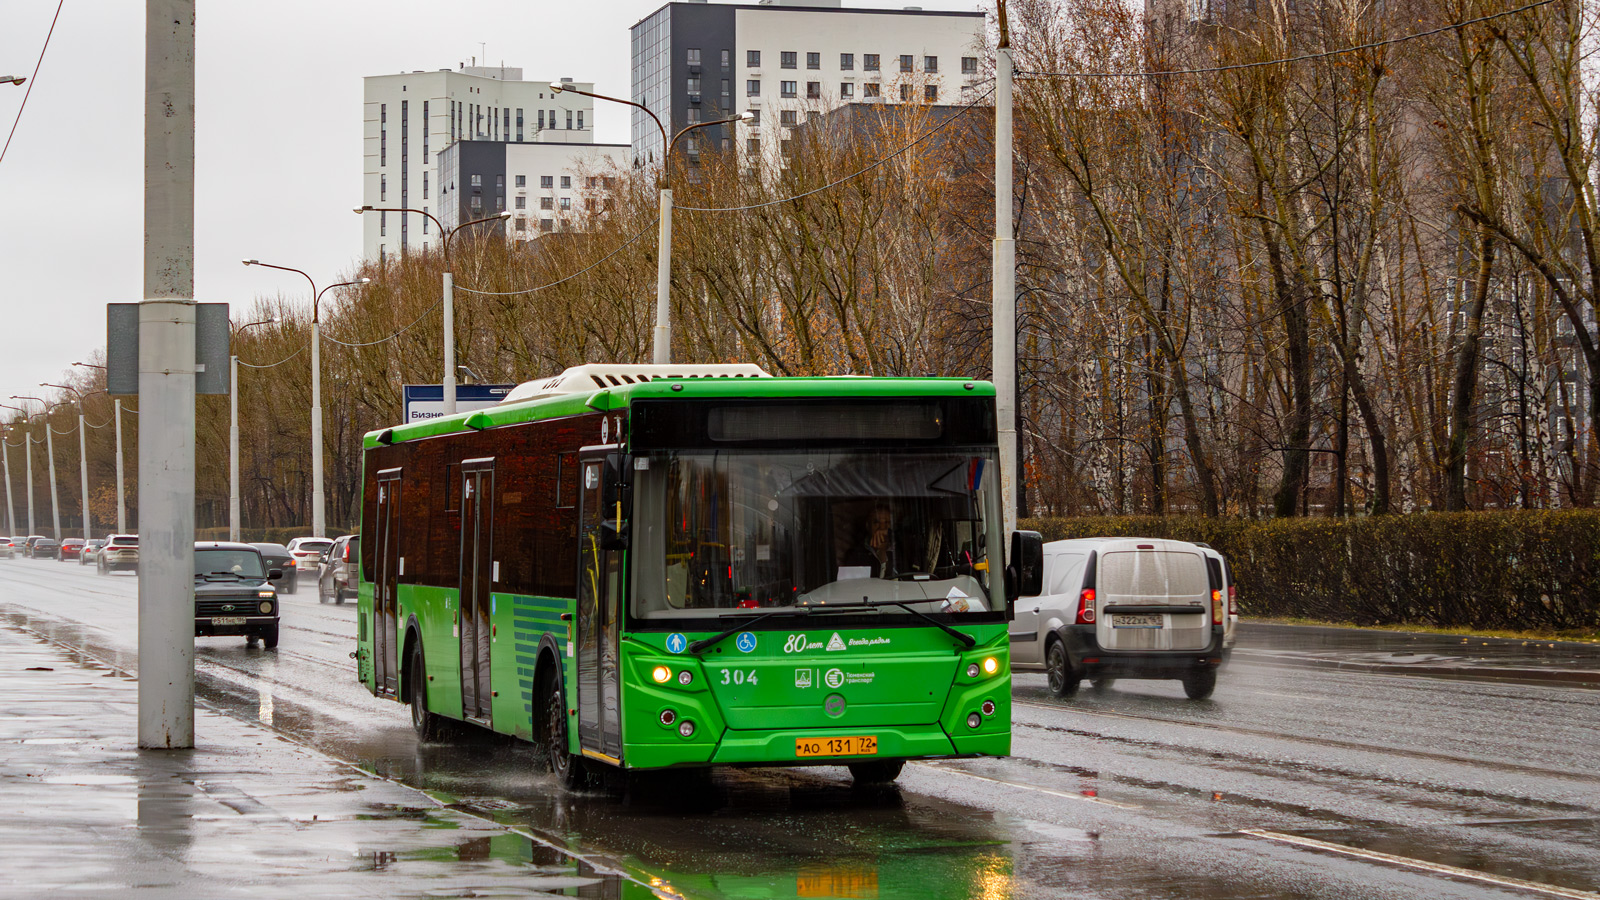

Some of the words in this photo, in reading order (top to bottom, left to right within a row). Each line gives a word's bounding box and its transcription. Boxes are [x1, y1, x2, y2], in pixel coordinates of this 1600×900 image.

[784, 634, 807, 653] 80
[806, 641, 824, 650] лет
[848, 637, 869, 646] Всегда
[720, 668, 758, 685] 304
[803, 743, 820, 754] АО
[827, 739, 851, 753] 131
[859, 738, 872, 748] 72
